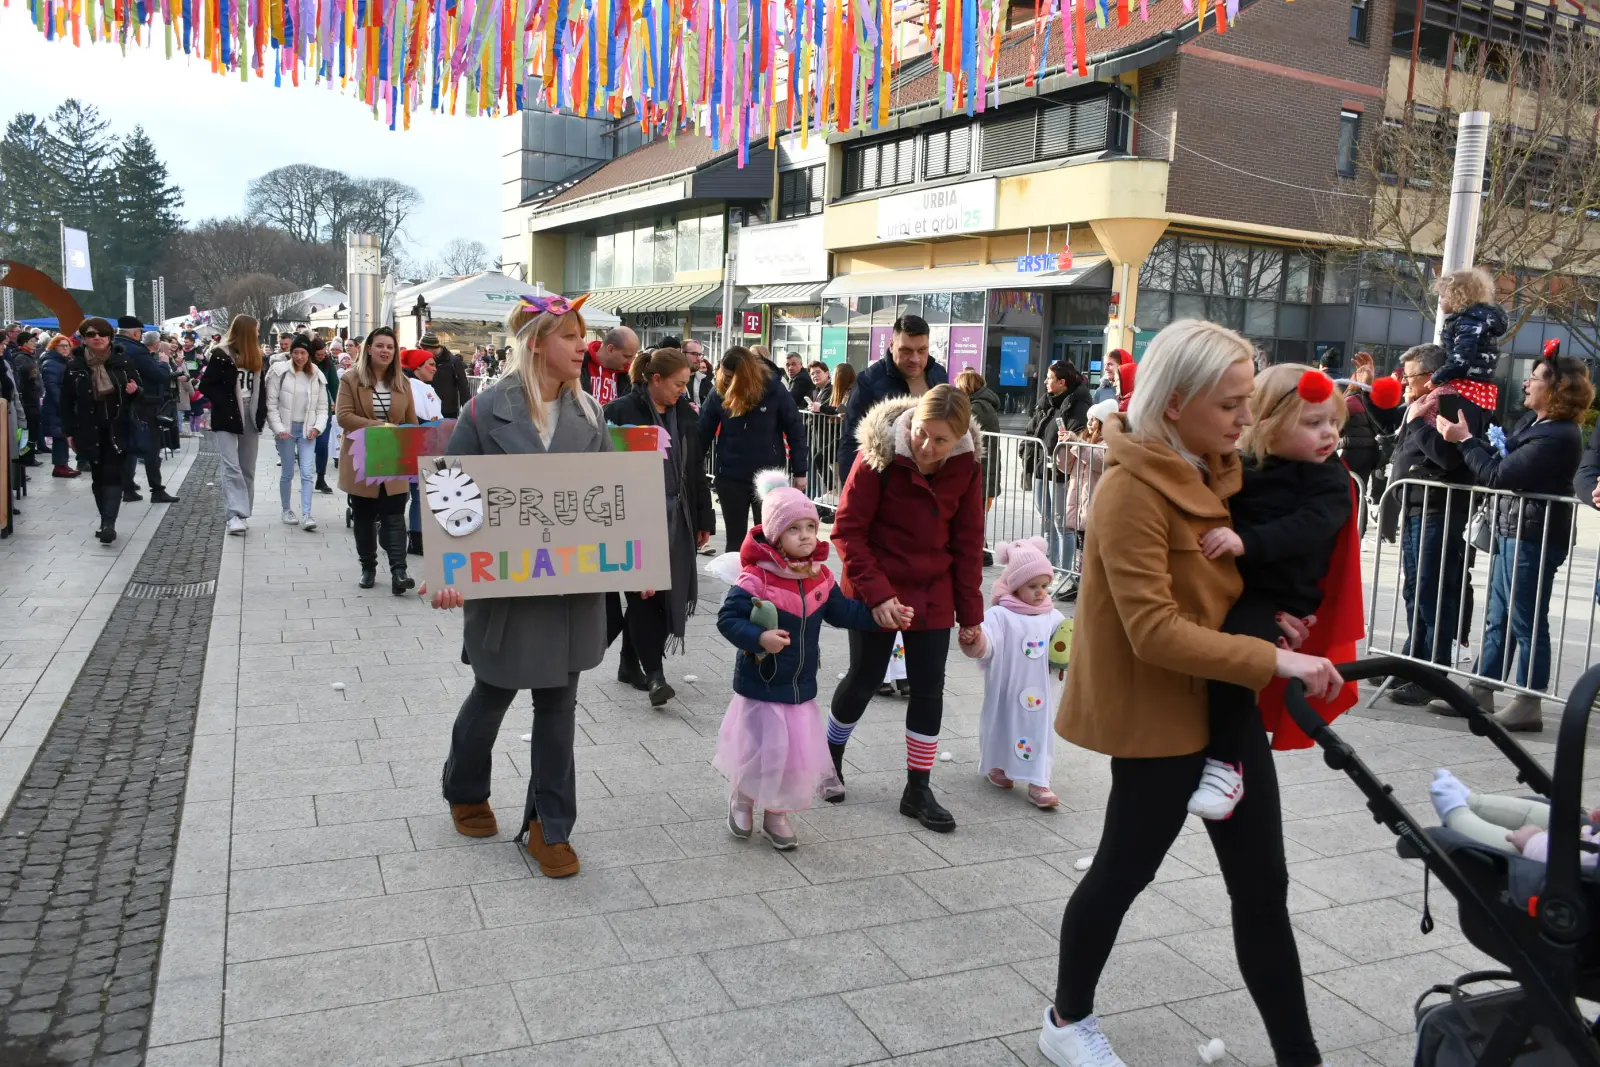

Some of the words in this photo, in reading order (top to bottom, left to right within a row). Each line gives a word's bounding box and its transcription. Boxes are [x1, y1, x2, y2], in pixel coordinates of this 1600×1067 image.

[923, 190, 957, 210] URBIA
[887, 216, 911, 237] urbi
[915, 217, 927, 234] et
[931, 213, 958, 233] orbi
[963, 209, 981, 228] 25
[1017, 253, 1057, 272] ERSTE
[487, 485, 625, 527] PRUGI
[442, 539, 641, 585] PRIJATELJI
